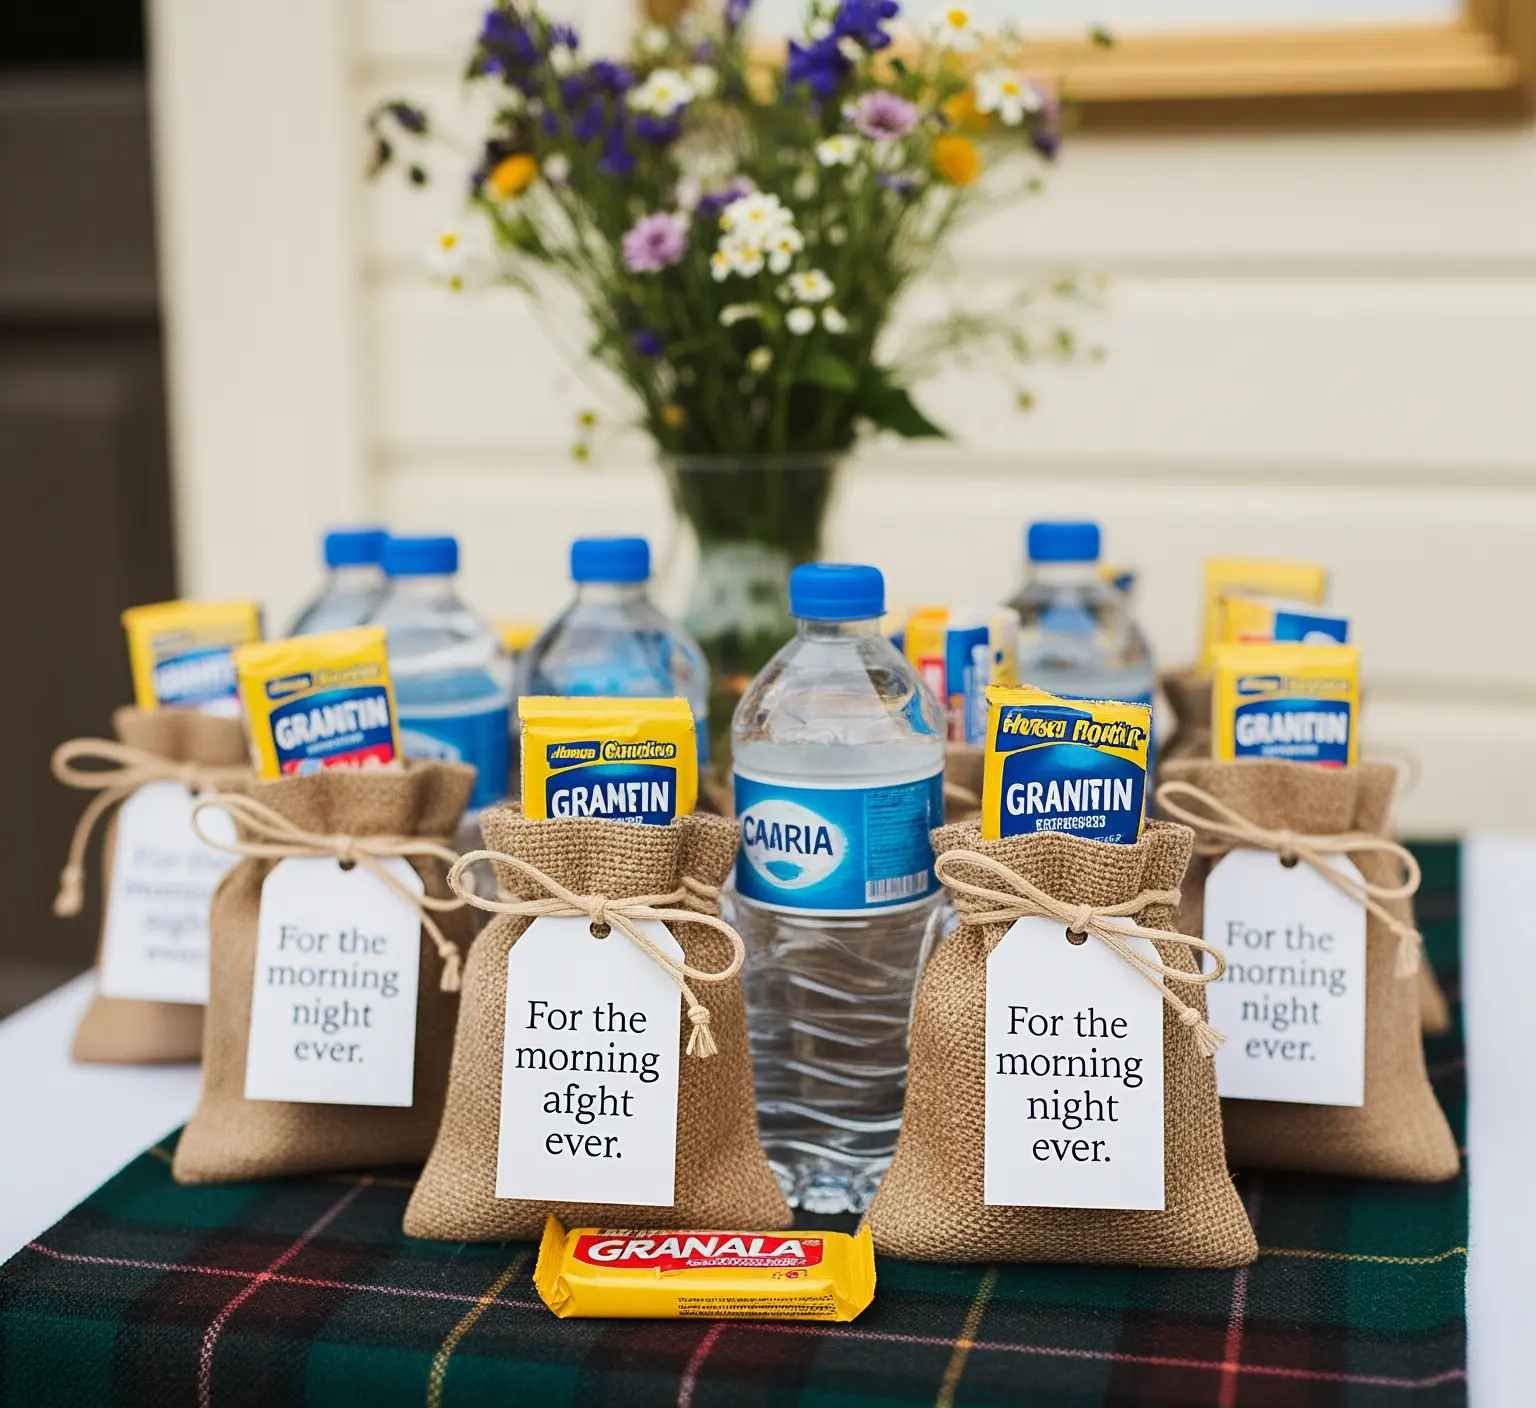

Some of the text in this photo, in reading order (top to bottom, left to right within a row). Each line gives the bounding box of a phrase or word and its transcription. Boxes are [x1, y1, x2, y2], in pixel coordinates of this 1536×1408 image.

[278, 925, 387, 955] For the
[1226, 920, 1334, 952] For the
[267, 961, 400, 998] morning
[293, 1000, 372, 1034] night
[525, 1000, 647, 1034] For the
[1006, 1005, 1128, 1039] For the
[1241, 995, 1319, 1032] night
[294, 1042, 363, 1063] ever.
[515, 1041, 661, 1083] morning
[1244, 1039, 1315, 1061] ever.
[995, 1047, 1144, 1089] morning
[543, 1082, 634, 1125] afght
[1026, 1088, 1120, 1131] night
[545, 1132, 622, 1159] ever.
[1032, 1139, 1111, 1163] ever.
[587, 1236, 807, 1262] GRANALA
